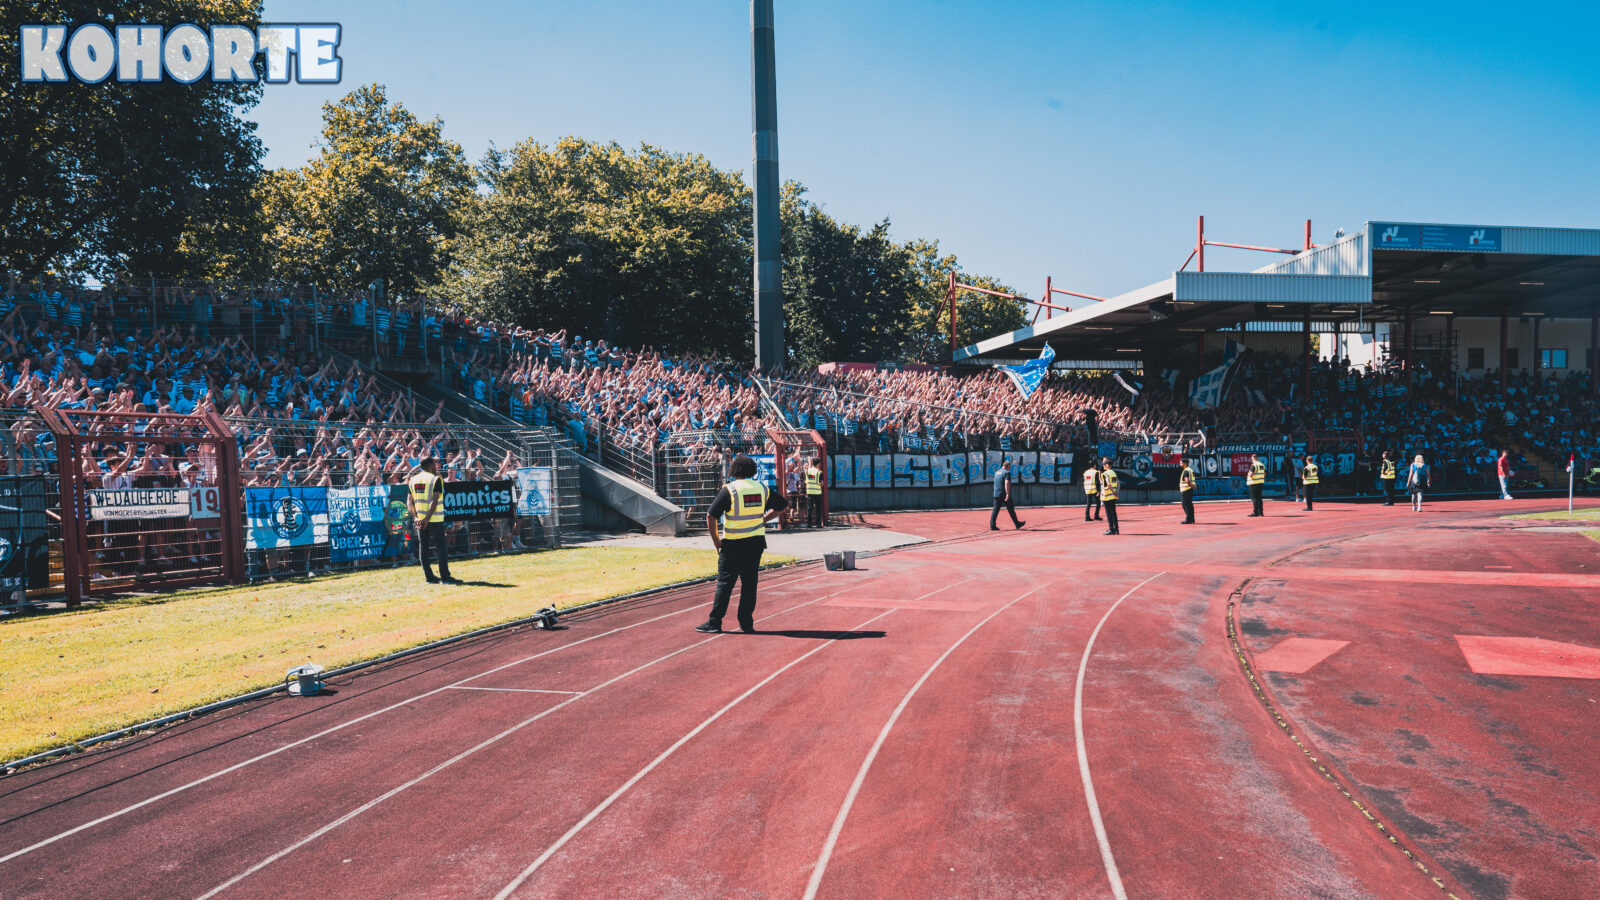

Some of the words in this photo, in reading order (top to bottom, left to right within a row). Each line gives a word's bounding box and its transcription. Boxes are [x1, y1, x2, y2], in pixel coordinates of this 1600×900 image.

[93, 490, 180, 506] WEDAUHERDE
[192, 489, 217, 512] 19
[443, 484, 511, 507] anatics
[329, 496, 384, 511] MEIDERICH
[330, 526, 342, 535] IST
[347, 548, 383, 558] BEKANNT
